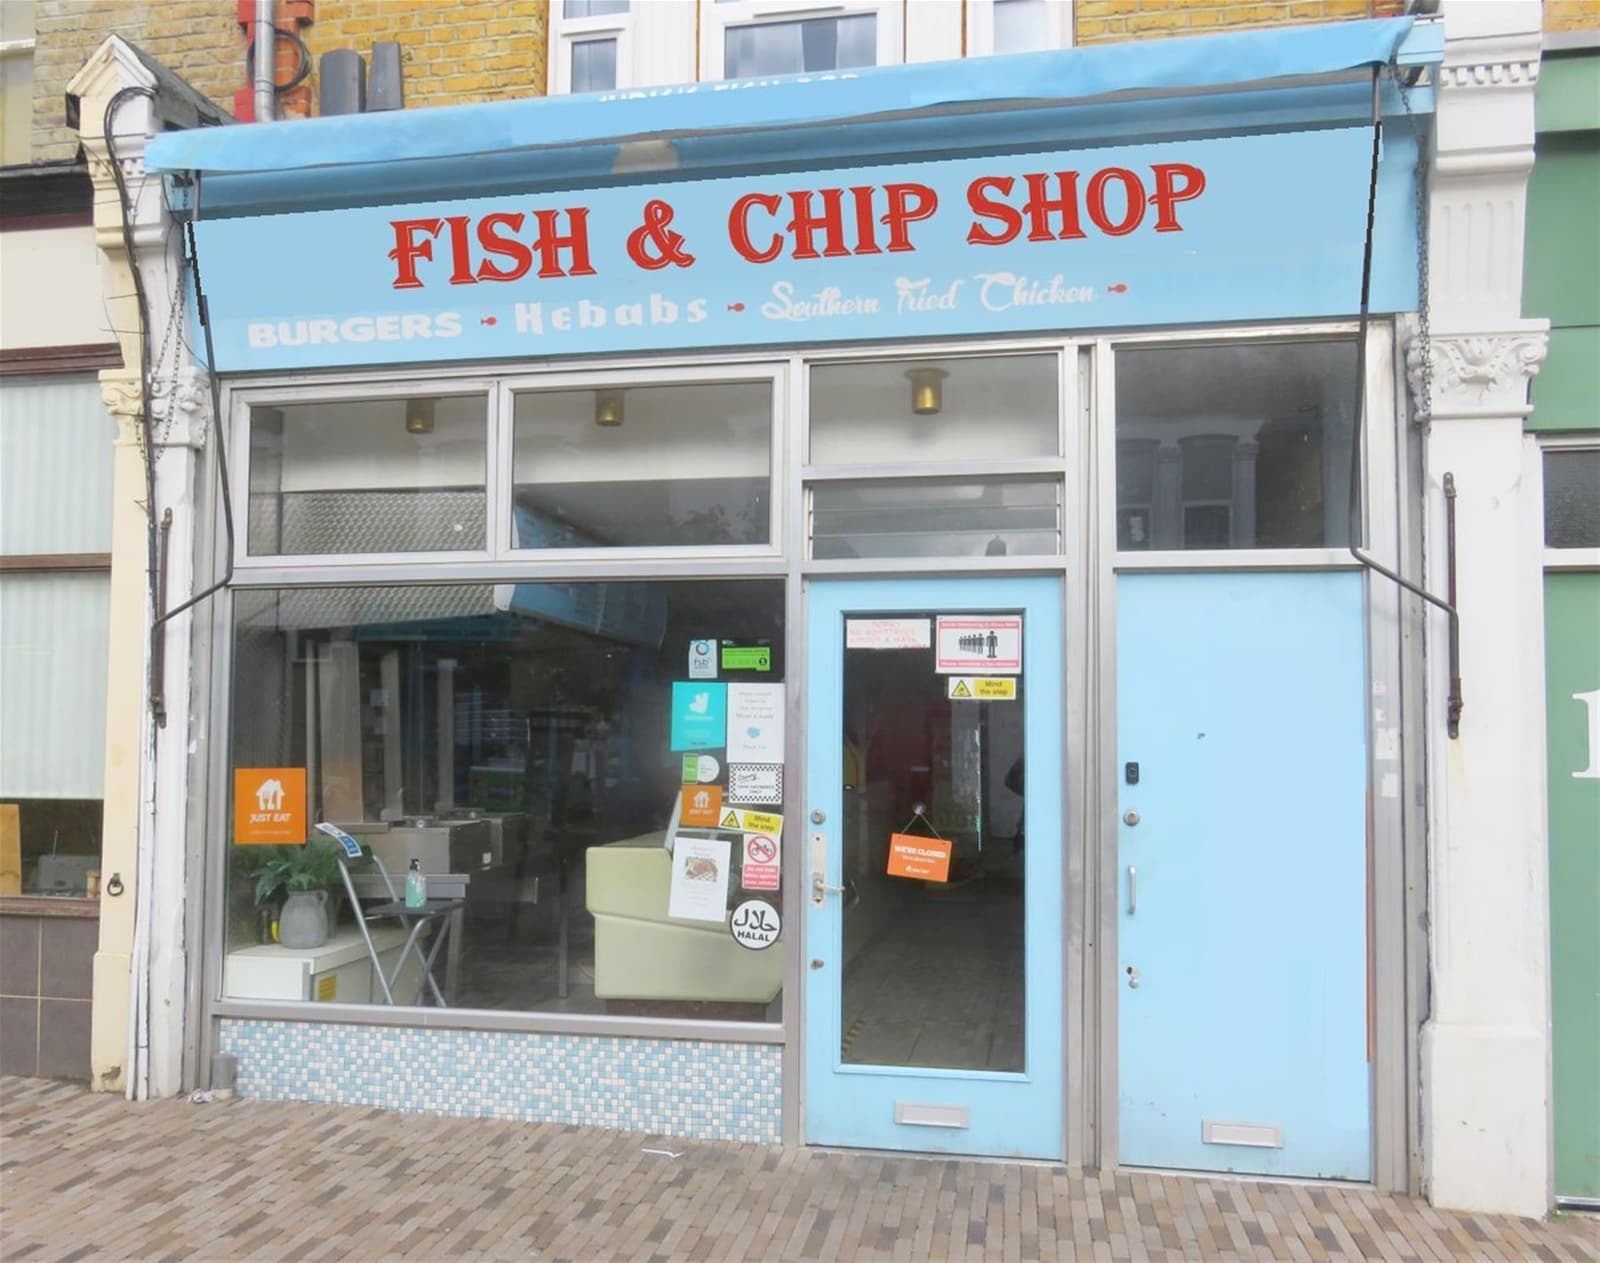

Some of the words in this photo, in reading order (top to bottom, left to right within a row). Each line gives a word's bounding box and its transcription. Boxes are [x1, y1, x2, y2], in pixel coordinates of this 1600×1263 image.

[387, 206, 597, 289] FISH
[626, 199, 696, 270] &
[727, 183, 938, 264] CHIP
[966, 163, 1206, 246] SHOP
[248, 312, 464, 348] BURGERS
[761, 281, 880, 321] Southern
[973, 272, 1095, 311] Chicken
[249, 813, 271, 824] JUST
[272, 812, 292, 823] EAT
[753, 815, 771, 823] Mind
[737, 931, 770, 942] HALAL
